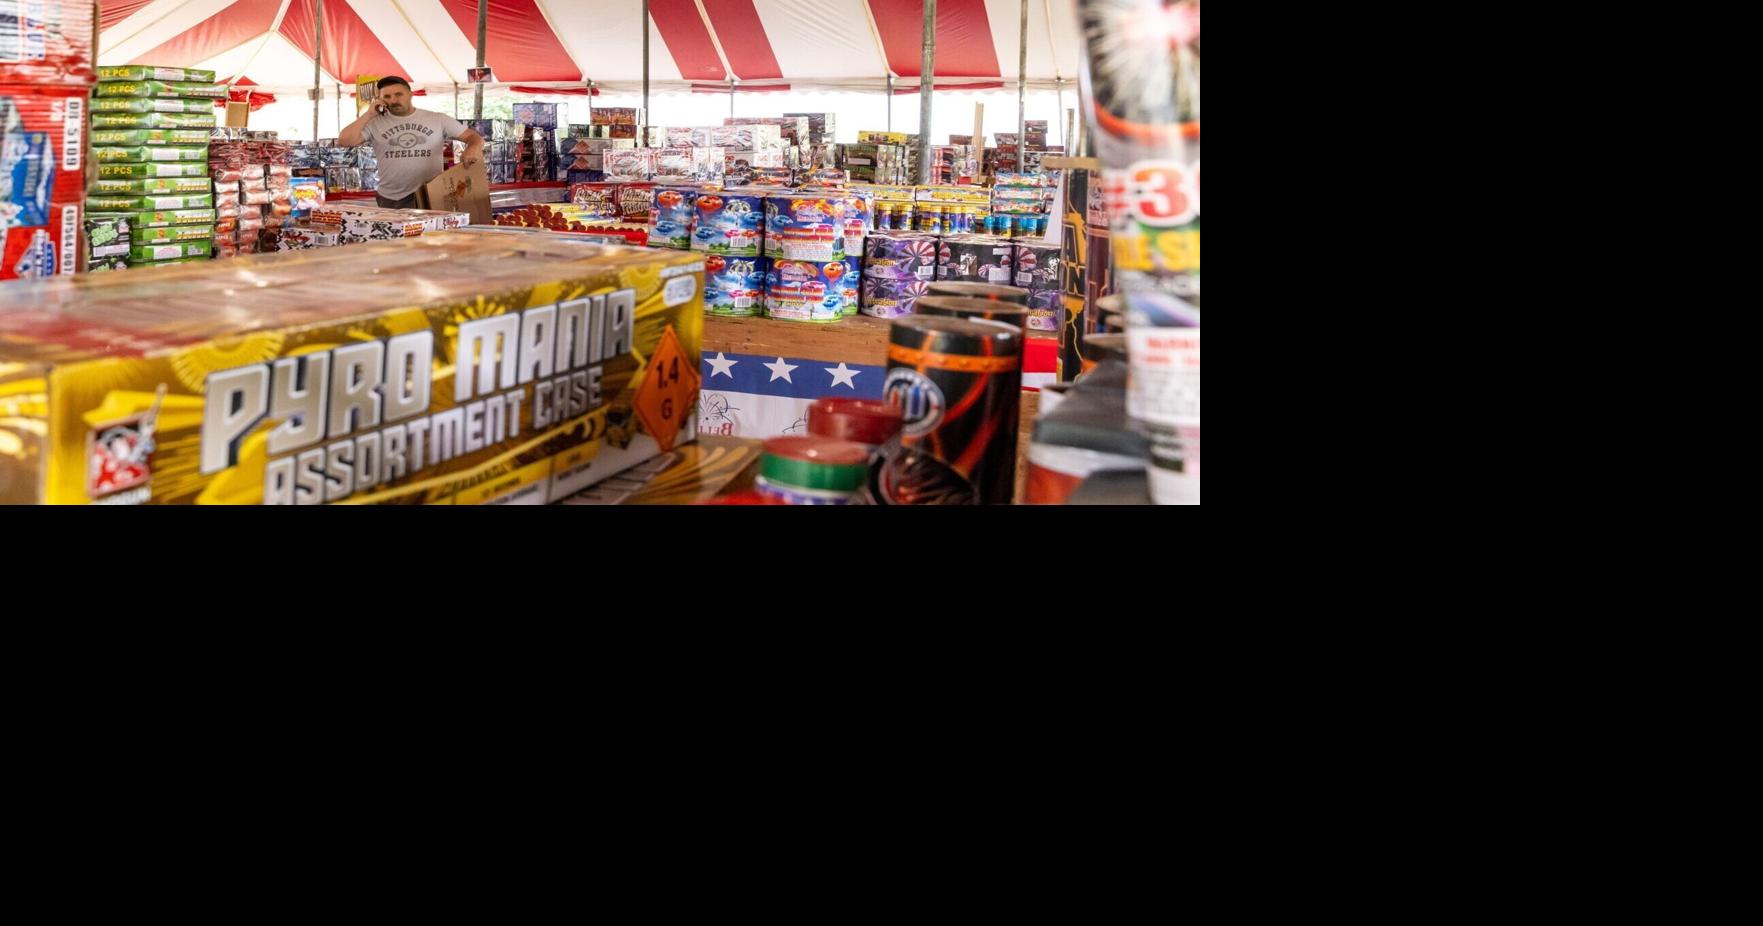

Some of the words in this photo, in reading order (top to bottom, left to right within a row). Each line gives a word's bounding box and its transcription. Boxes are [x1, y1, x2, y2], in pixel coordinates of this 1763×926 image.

[100, 69, 110, 77] 12
[112, 69, 130, 77] PCS
[381, 123, 434, 140] PITTSBURGH
[384, 149, 432, 159] STEELERS
[100, 167, 110, 175] 12
[114, 167, 132, 175] PCS
[100, 183, 111, 191] 12
[112, 183, 131, 191] PCS
[100, 199, 110, 207] 12
[112, 199, 131, 207] PCS
[655, 355, 681, 390] 1.4
[201, 329, 433, 475] PYRO
[455, 288, 636, 401] MANIA
[660, 397, 674, 421] G
[263, 388, 526, 504] ASSORTMENT
[532, 365, 603, 430] CASE
